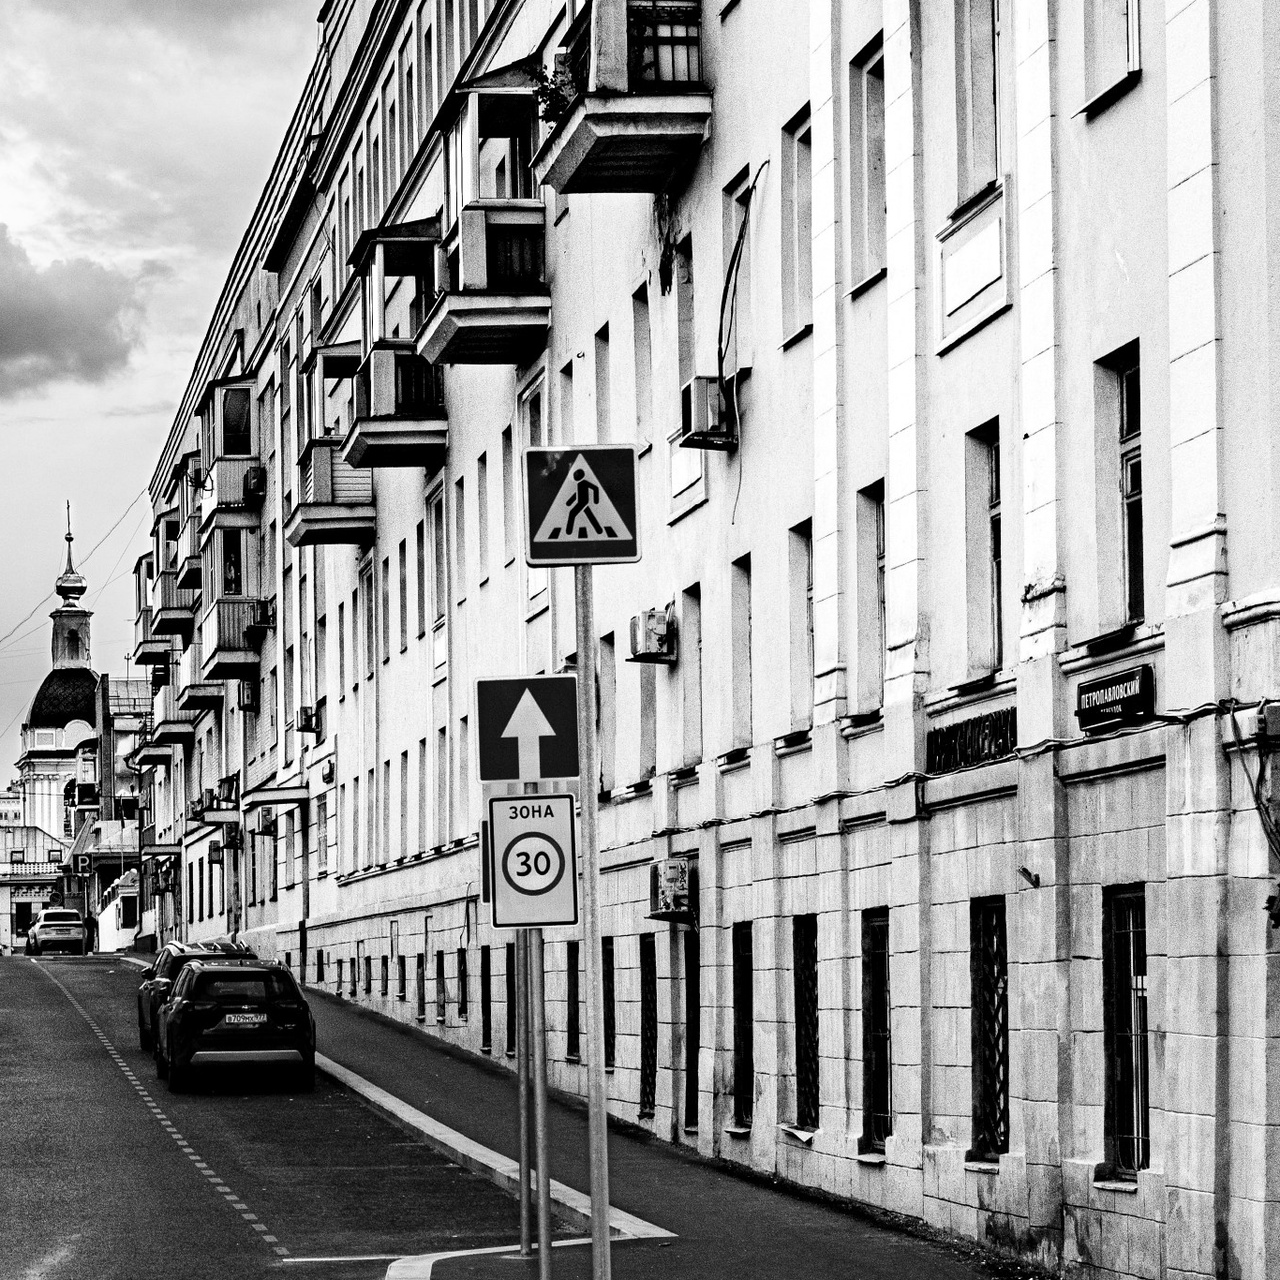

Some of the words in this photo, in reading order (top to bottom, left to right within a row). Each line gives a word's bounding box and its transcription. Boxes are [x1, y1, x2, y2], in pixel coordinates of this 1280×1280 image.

[1081, 676, 1140, 709] ПЕТРОПАВЛОВСКИЙ
[509, 804, 555, 820] ЗОНА
[516, 851, 551, 877] 30
